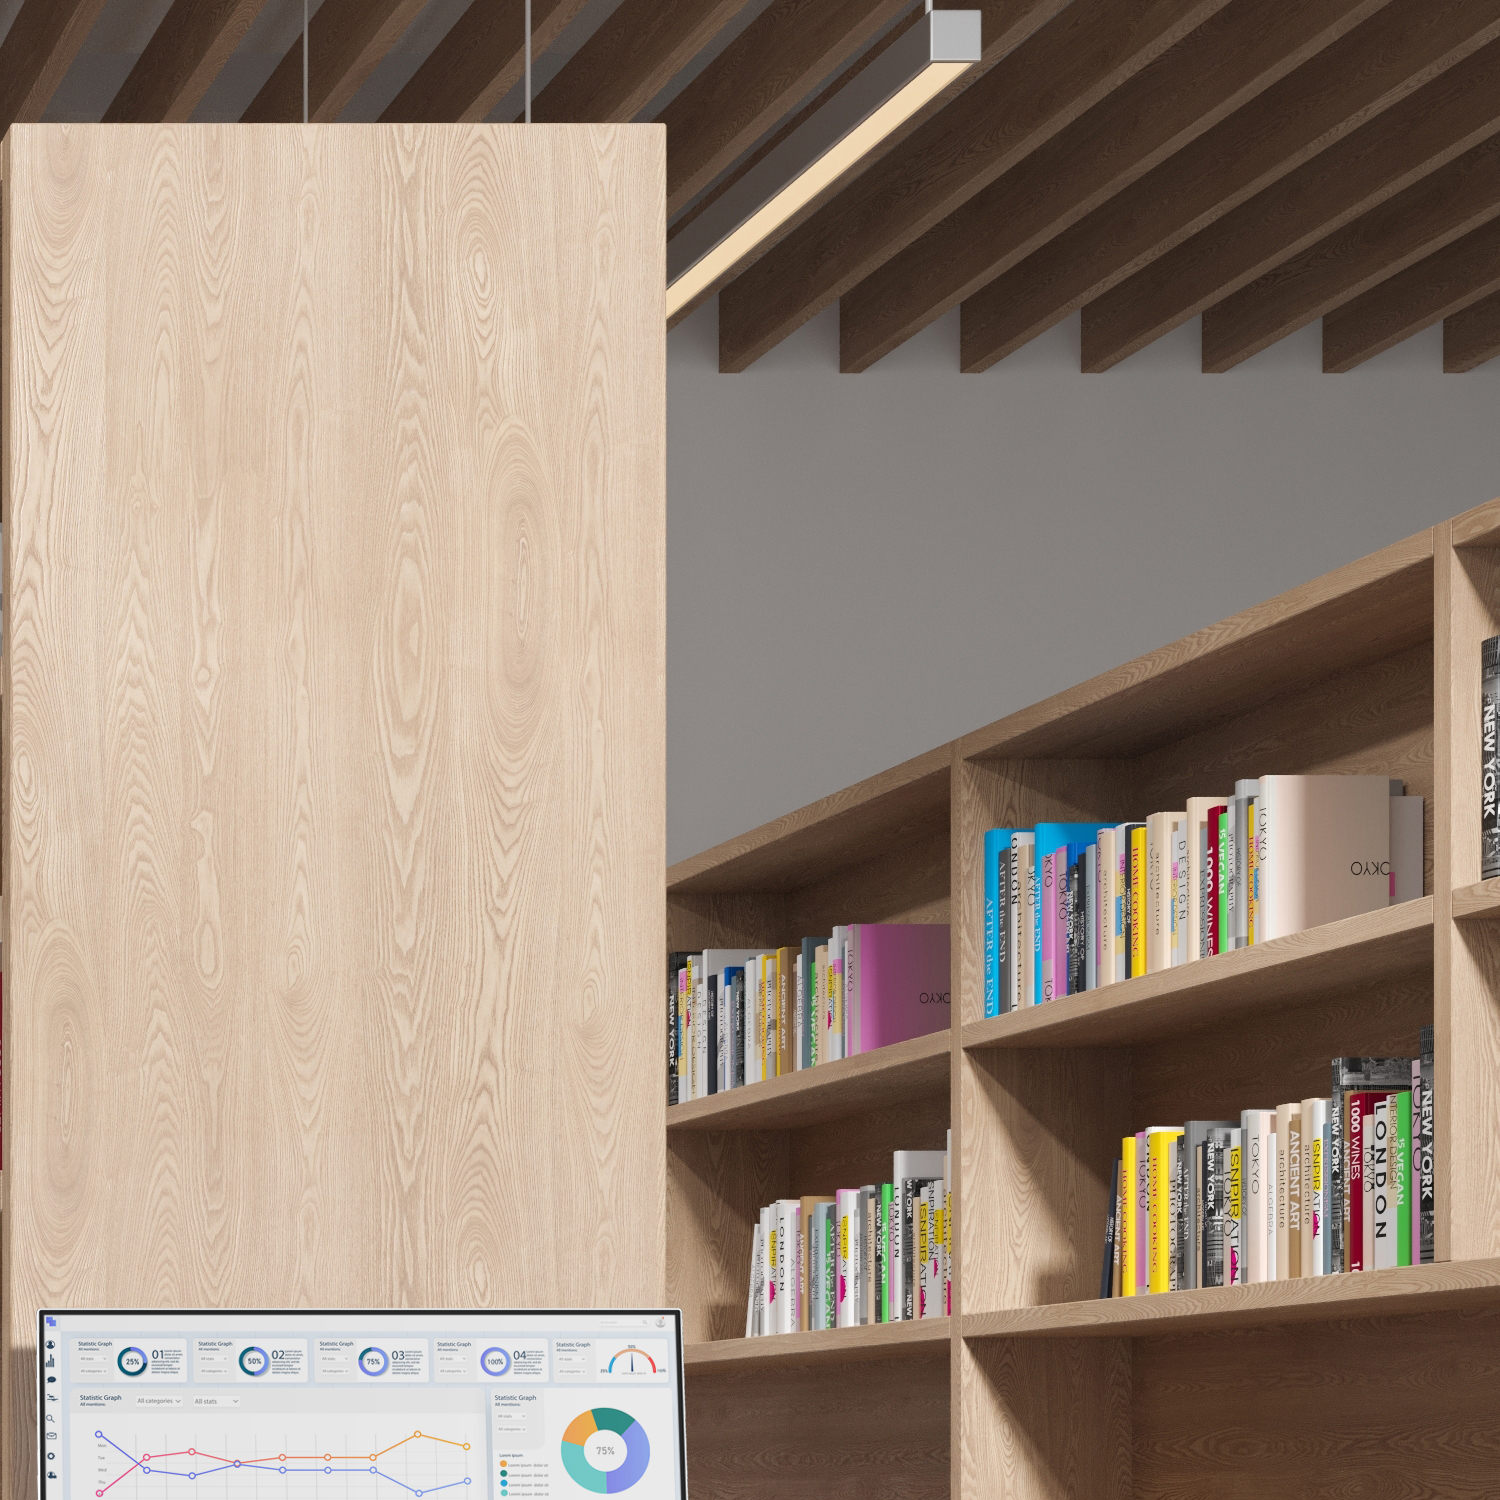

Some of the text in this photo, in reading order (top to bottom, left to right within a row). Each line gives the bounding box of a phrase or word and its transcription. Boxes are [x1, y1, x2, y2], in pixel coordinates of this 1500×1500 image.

[1483, 704, 1496, 820] NEW YORK
[1351, 861, 1390, 875] OKYO
[919, 992, 951, 1003] OKYO
[1351, 1100, 1360, 1180] 1000 WINES
[1422, 1089, 1432, 1199] NEW YORK
[1375, 1103, 1386, 1239] LONDON
[1289, 1131, 1300, 1230] ANCIENT ART
[152, 1350, 164, 1359] 01
[272, 1350, 285, 1359] 02
[391, 1350, 405, 1360] 03
[513, 1350, 527, 1360] 04
[596, 1447, 615, 1455] 75%
